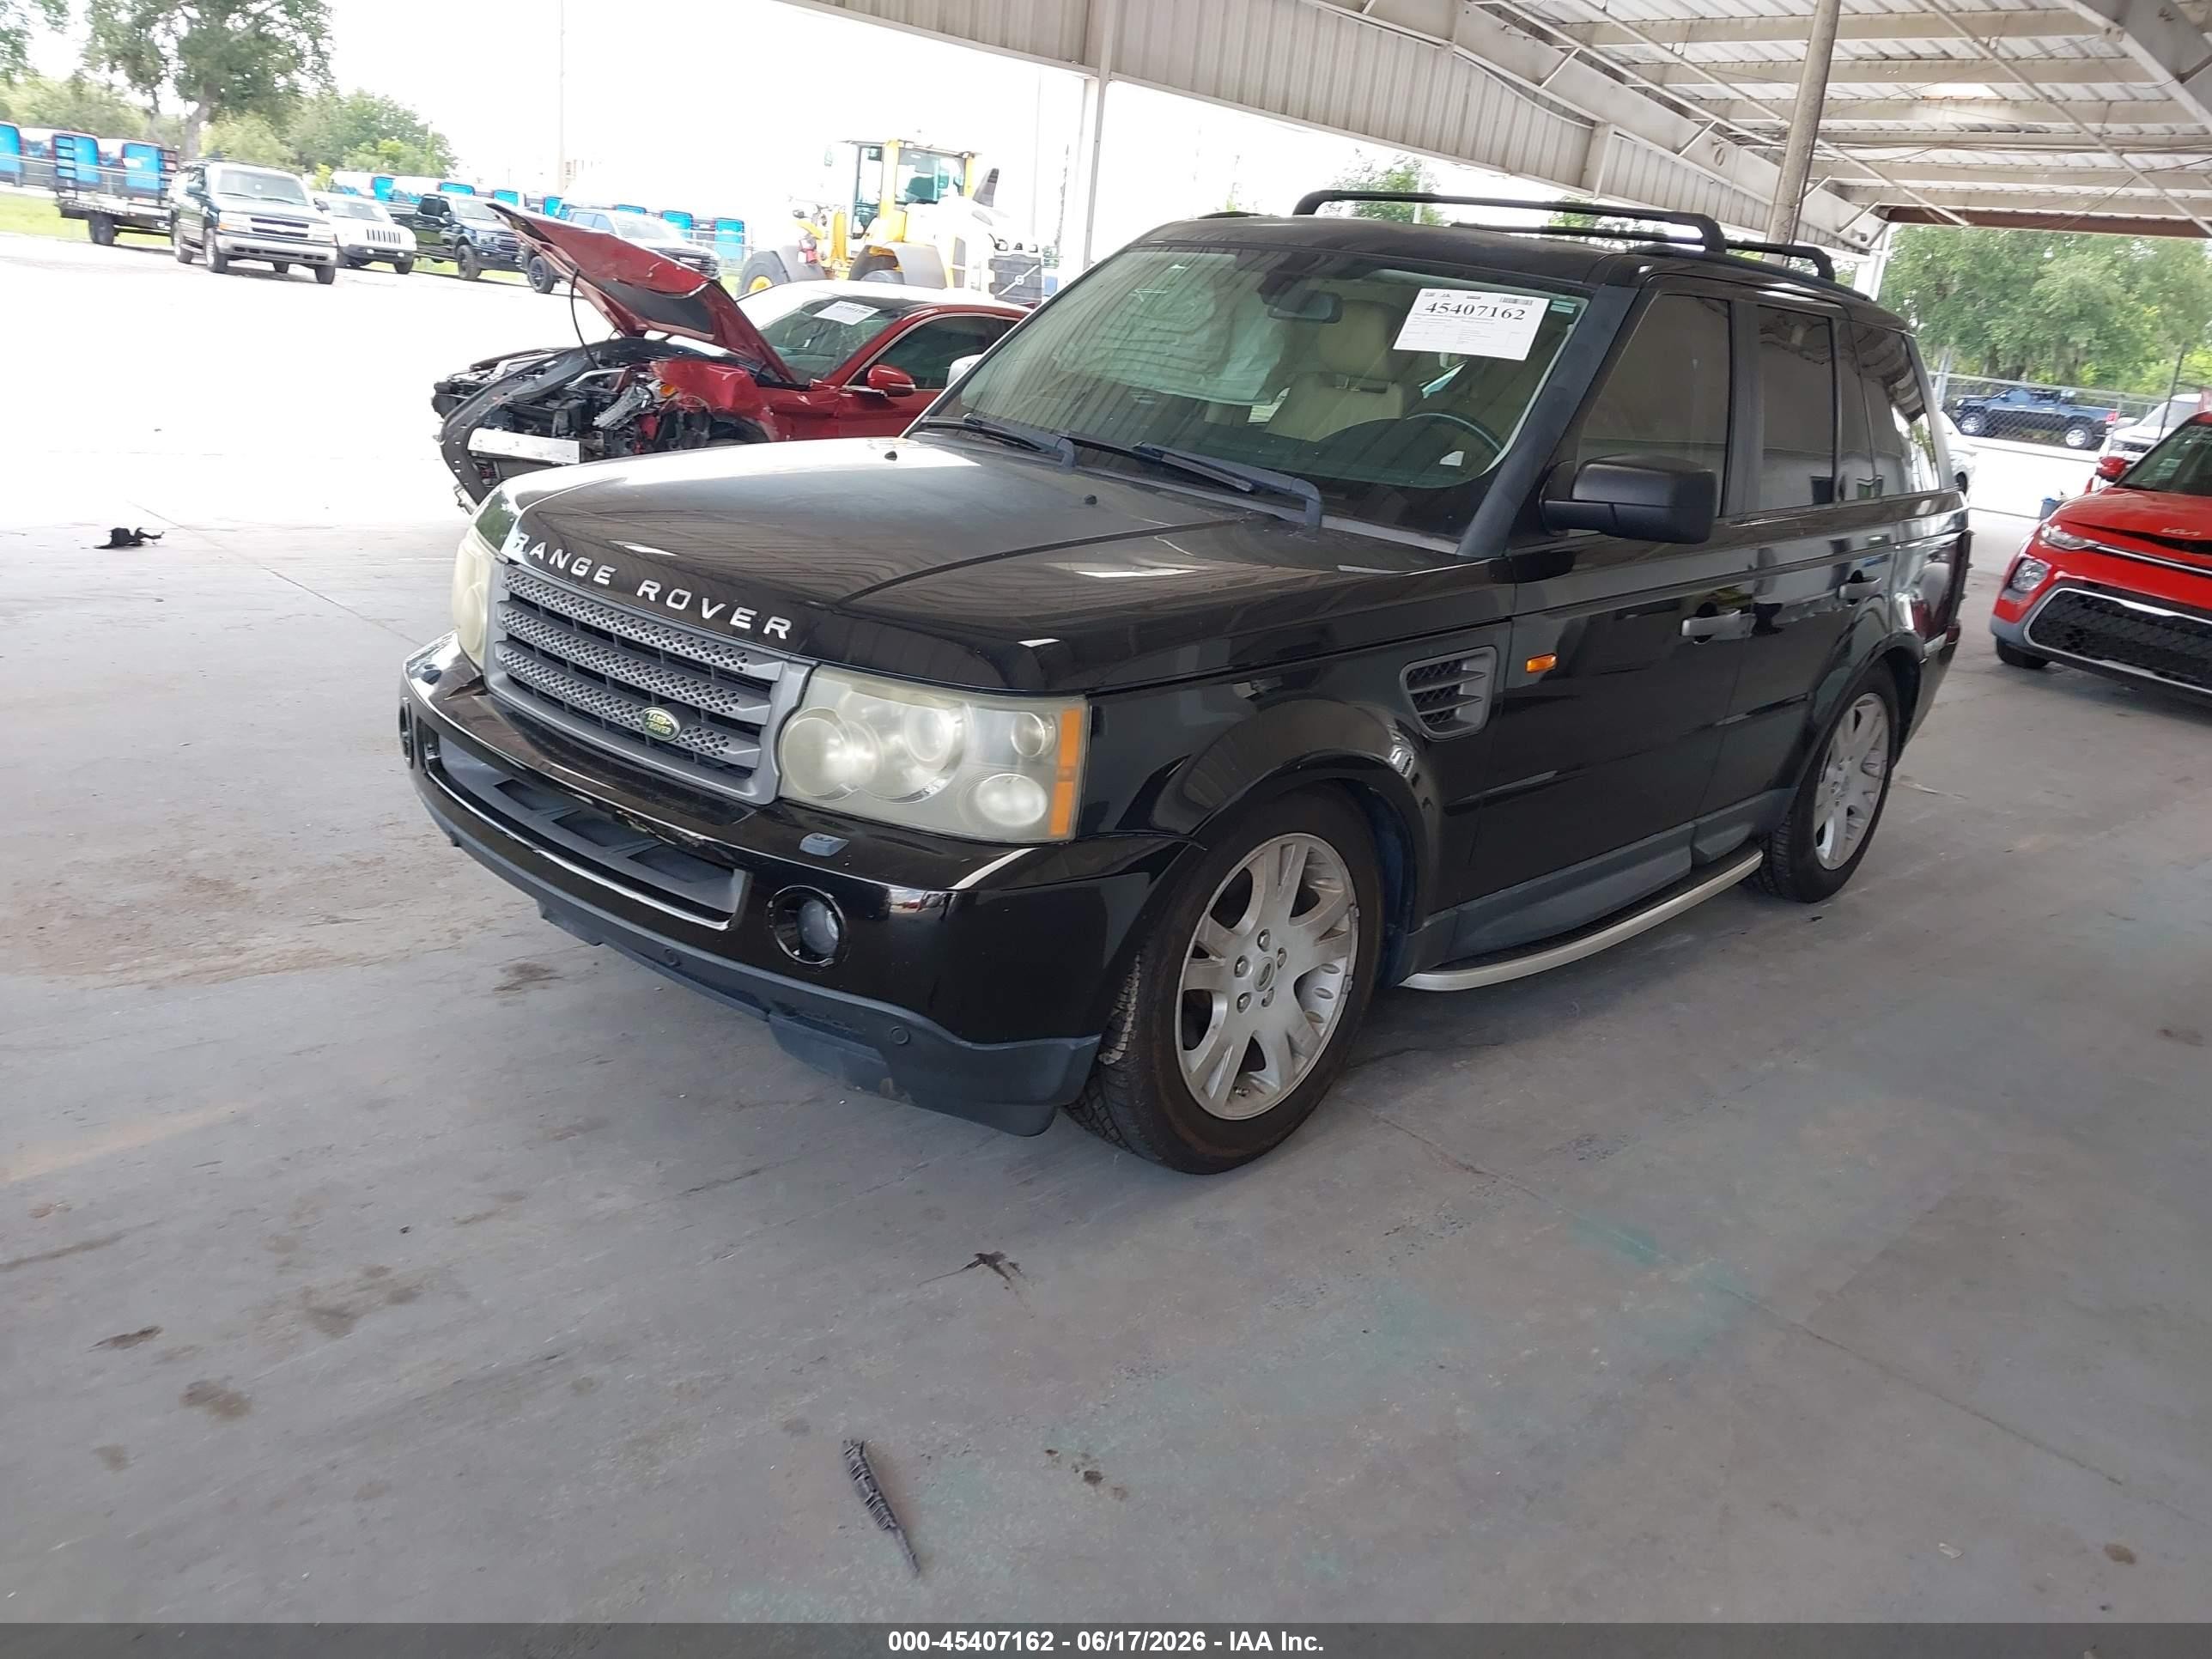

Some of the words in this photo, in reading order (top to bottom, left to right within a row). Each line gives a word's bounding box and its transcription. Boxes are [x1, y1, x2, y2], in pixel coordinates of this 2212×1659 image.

[1425, 302, 1525, 320] 45407162
[513, 532, 617, 586] RANGE
[636, 580, 792, 640] ROVER
